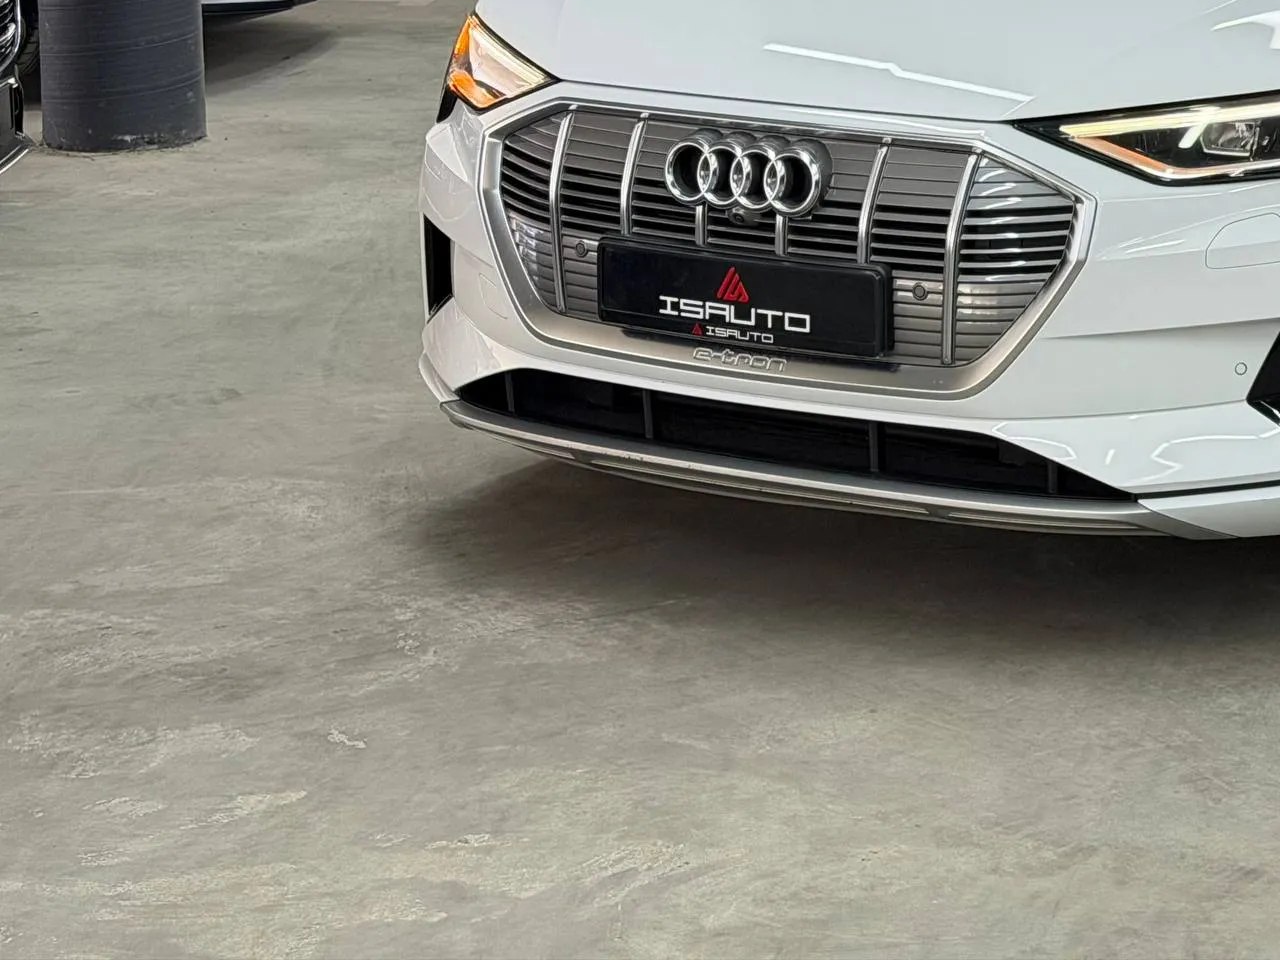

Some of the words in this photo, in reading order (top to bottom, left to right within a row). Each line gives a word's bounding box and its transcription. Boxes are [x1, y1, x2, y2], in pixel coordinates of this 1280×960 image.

[659, 295, 810, 333] ISAUTO
[706, 326, 774, 343] ISAUTO
[693, 347, 787, 372] e-tron
